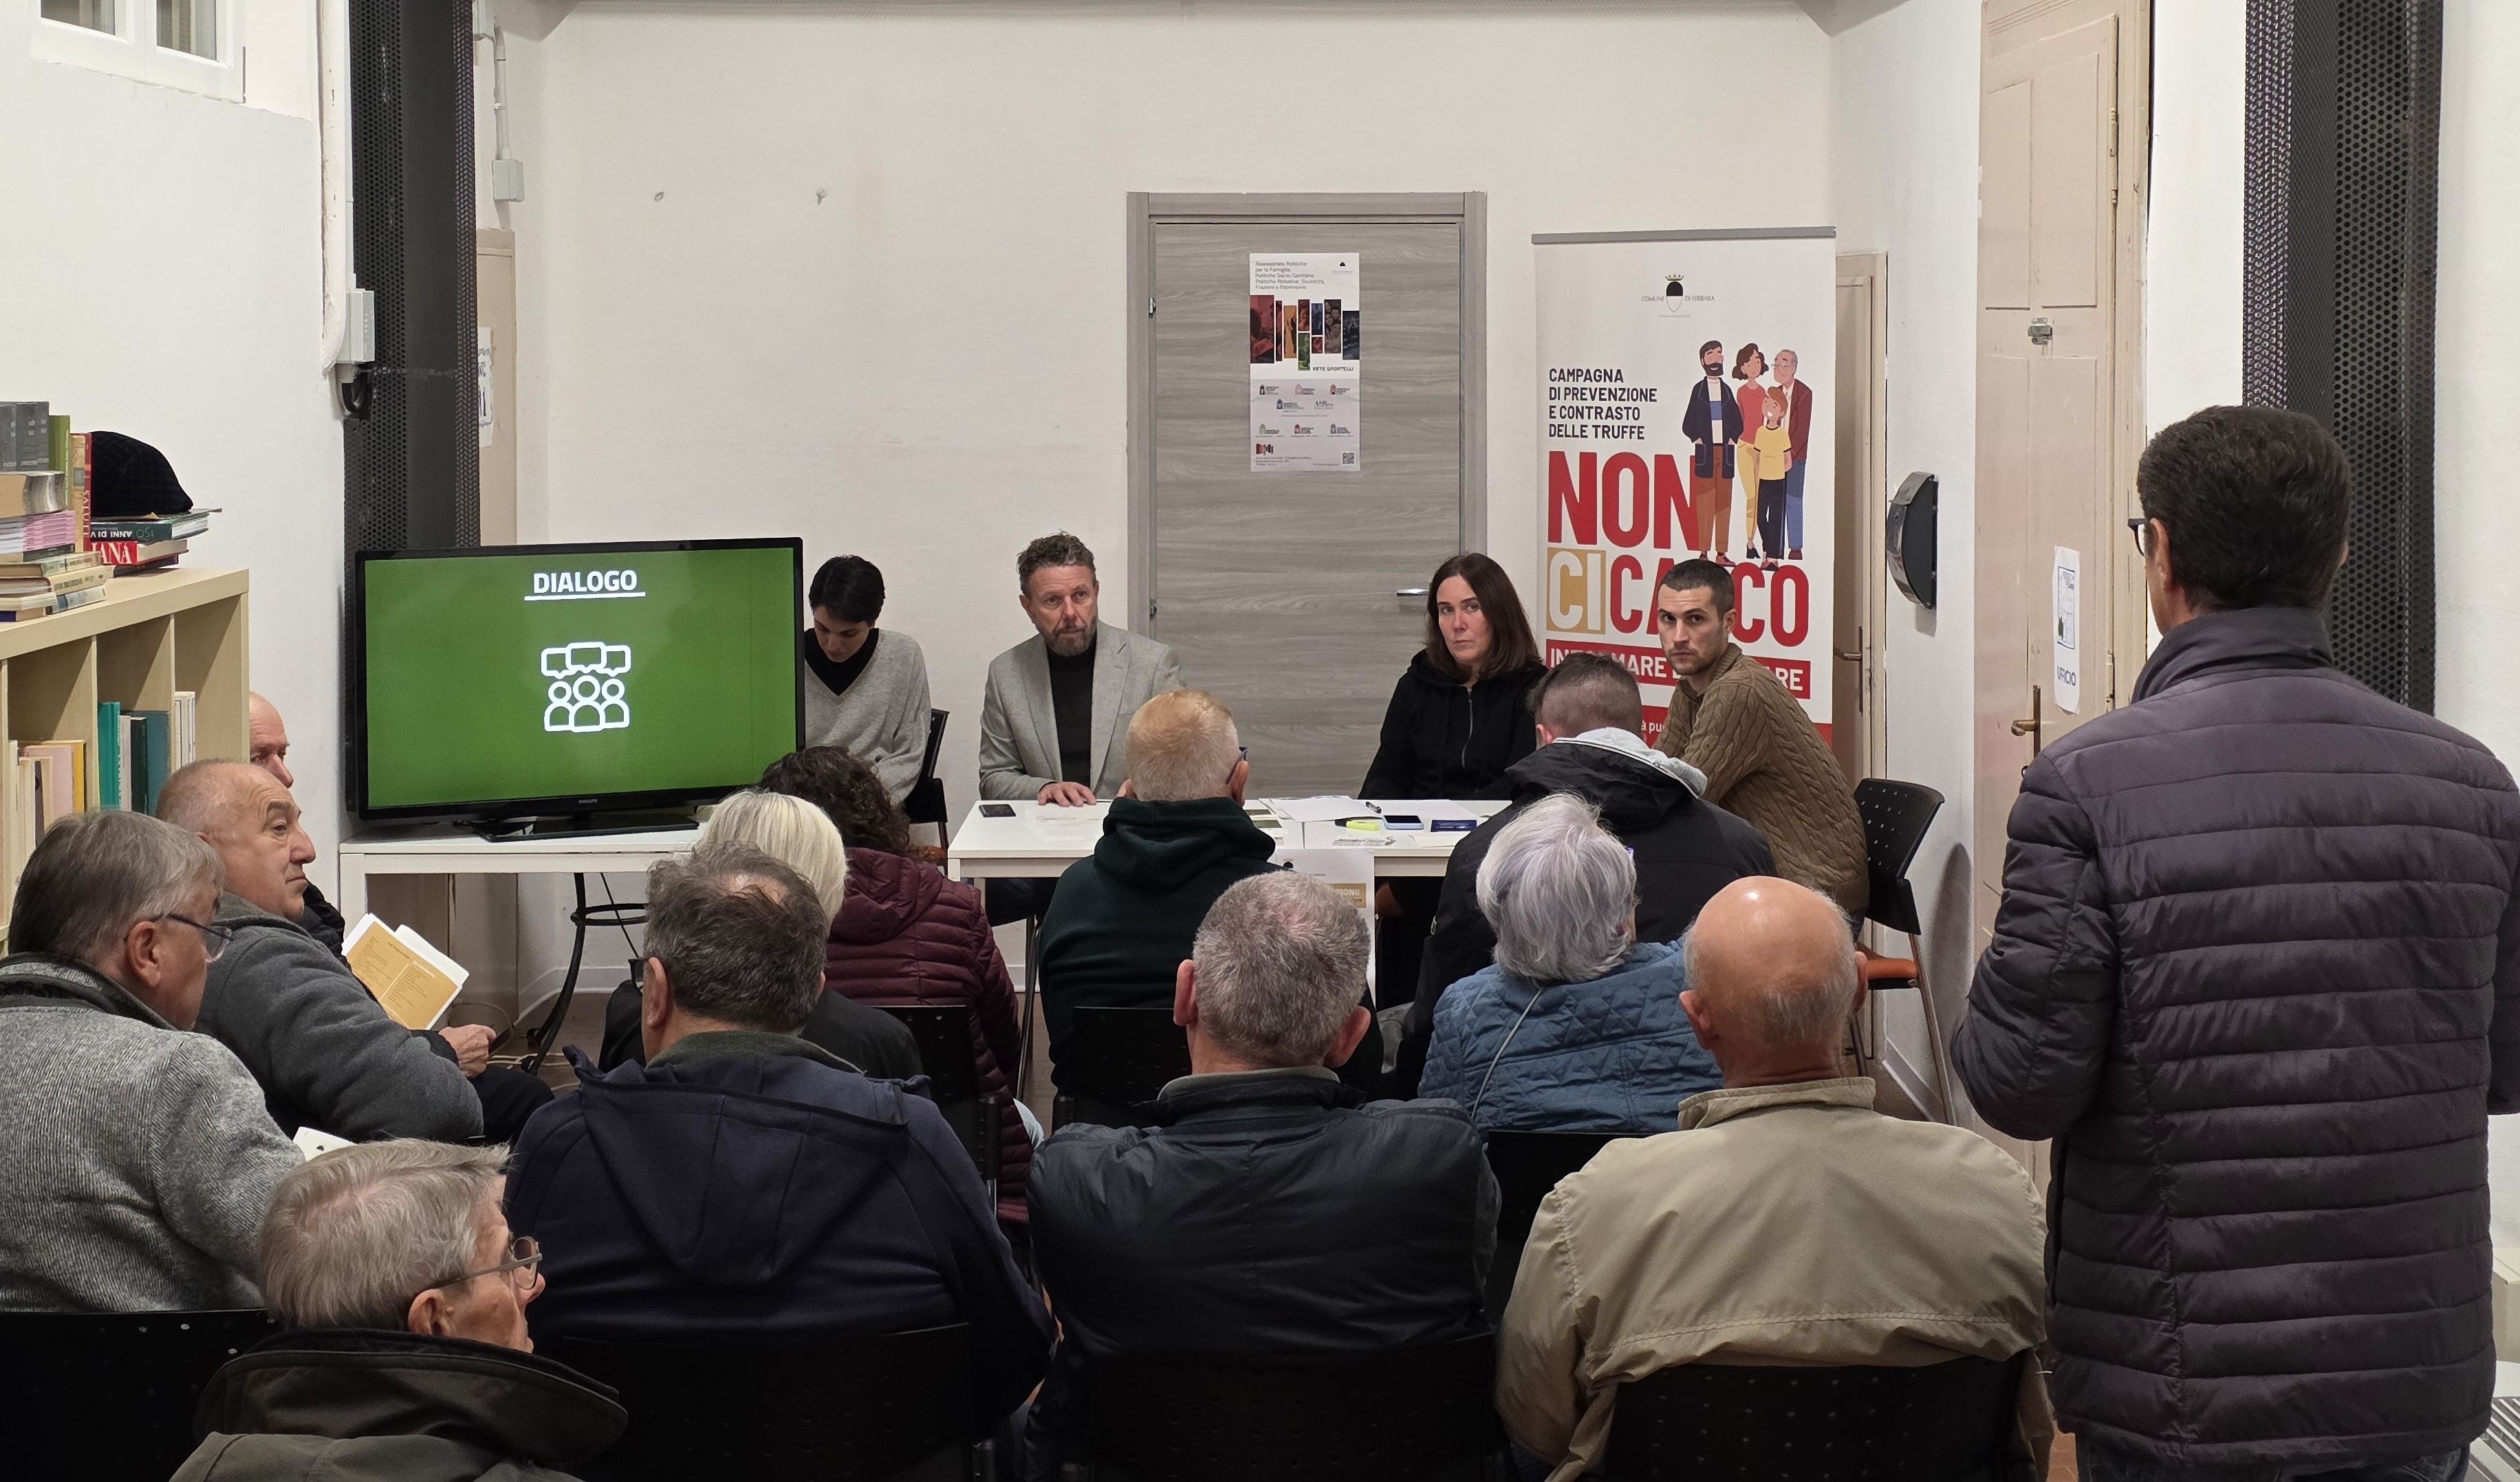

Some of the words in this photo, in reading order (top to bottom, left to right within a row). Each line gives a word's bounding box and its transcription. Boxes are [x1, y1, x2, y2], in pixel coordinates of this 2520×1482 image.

[1550, 369, 1623, 382] CAMPAGNA
[1550, 387, 1561, 400] DI
[1564, 387, 1657, 402] PREVENZIONE
[1550, 406, 1556, 419] E
[1559, 406, 1640, 420] CONTRASTO
[1549, 424, 1588, 438] DELLE
[1592, 425, 1644, 439] TRUFFE
[1548, 451, 1702, 551] NON
[111, 530, 133, 538] ANNI
[534, 570, 637, 593] DIALOGO
[1550, 551, 1601, 631] CI
